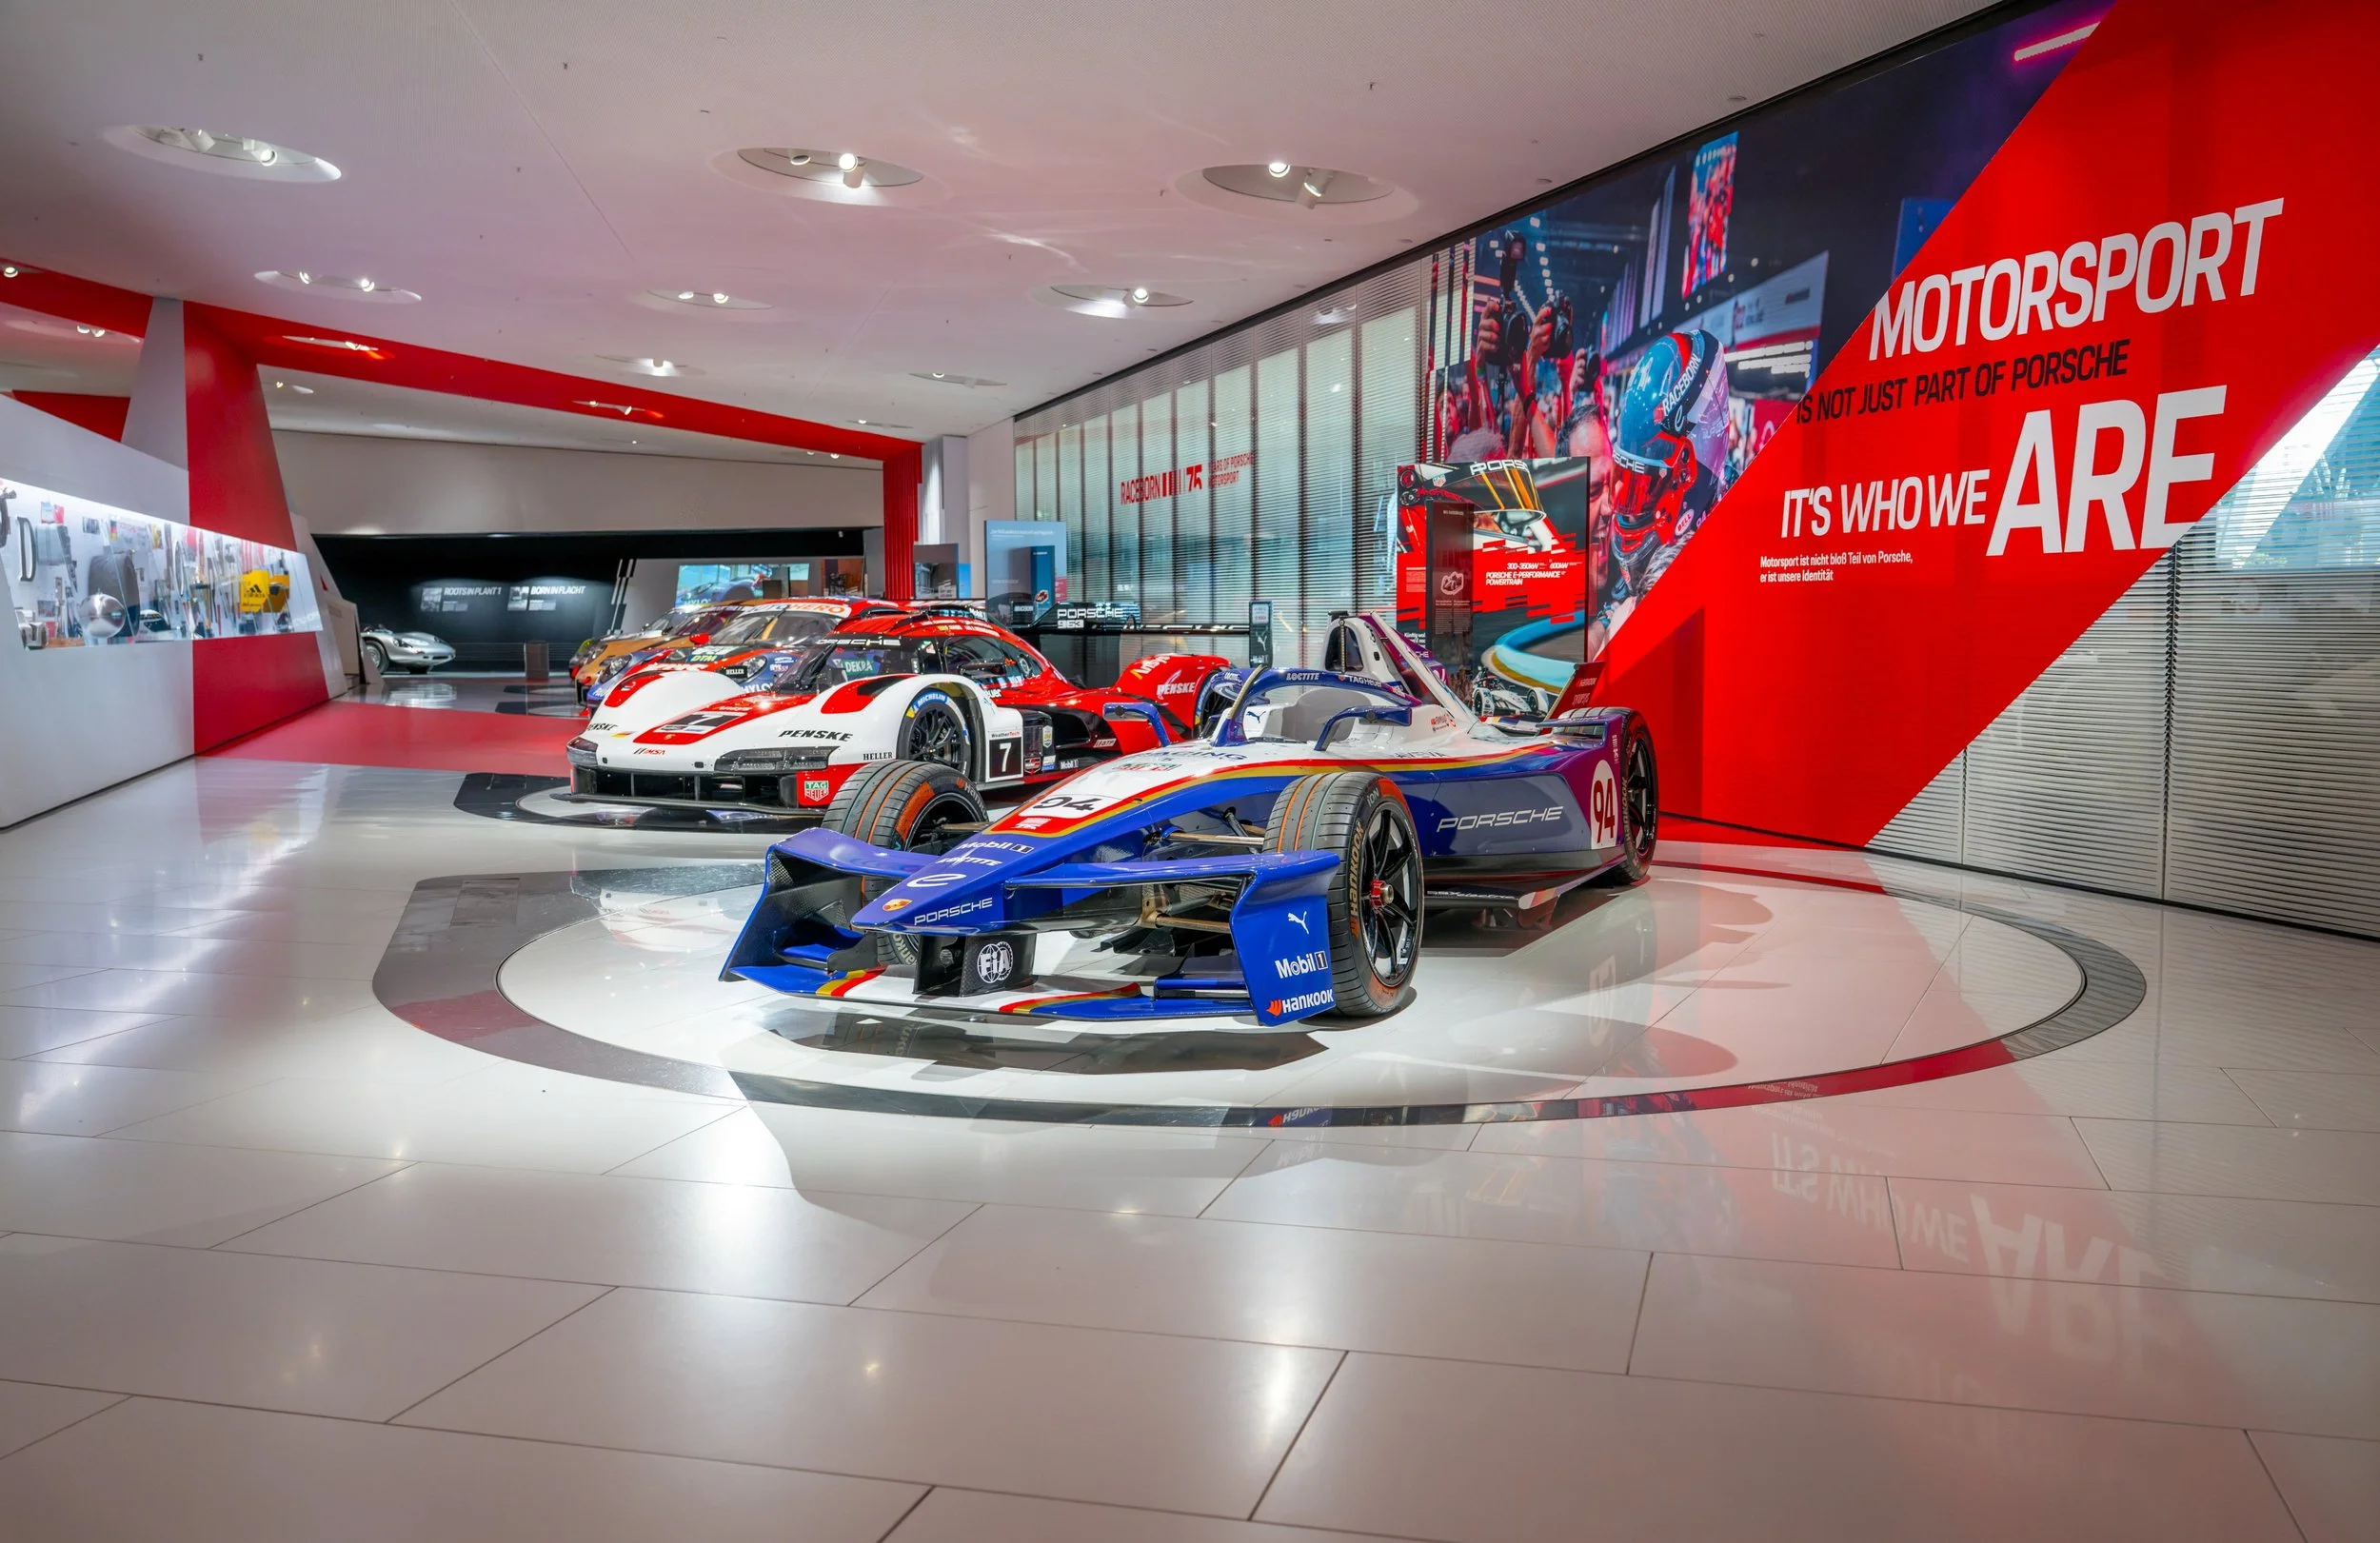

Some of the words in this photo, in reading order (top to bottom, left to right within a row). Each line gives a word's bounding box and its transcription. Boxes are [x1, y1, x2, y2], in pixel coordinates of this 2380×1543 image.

[1869, 197, 2284, 361] MOTORSPORT
[1662, 353, 1701, 416] RACEBORN
[1796, 393, 1813, 425] IS
[1817, 386, 1856, 421] NOT
[1857, 377, 1908, 413] JUST
[1914, 366, 1972, 406] PART
[1975, 361, 2004, 397] OF
[2011, 339, 2130, 391] PORSCHE
[1614, 452, 1645, 474] SCHE
[1929, 469, 1991, 526] WE
[1986, 385, 2227, 557] ARE
[1121, 475, 1160, 504] RACEBORN
[1760, 555, 1798, 569] Motorsport
[1799, 554, 1809, 566] ist
[1811, 553, 1830, 565] nicht
[1830, 552, 1847, 565] bloß
[1848, 551, 1862, 564] Teil
[1862, 552, 1877, 564] von
[1878, 549, 1914, 564] Porsche,
[1760, 572, 1768, 583] er
[1768, 571, 1777, 583] ist
[1777, 570, 1801, 583] unsere
[1802, 569, 1834, 582] Identität
[530, 586, 549, 595] BORN
[556, 586, 585, 595] FLACHT
[1057, 608, 1123, 619] PORSCHE
[845, 660, 873, 672] DEKRA
[1286, 672, 1319, 681] LOCTITE
[1157, 682, 1196, 696] PENSKE
[918, 692, 946, 707] MICHELIN
[778, 729, 853, 742] PENSKE
[863, 752, 893, 761] HELLER
[1000, 742, 1011, 773] 7
[1060, 761, 1074, 769] Mobil
[1033, 797, 1102, 812] 94
[1594, 778, 1616, 843] 94
[1437, 806, 1563, 832] PORSCHE
[956, 841, 1013, 850] Mobil
[914, 898, 993, 925] PORSCHE
[1275, 952, 1315, 979] Mobil
[1316, 952, 1328, 969] 1
